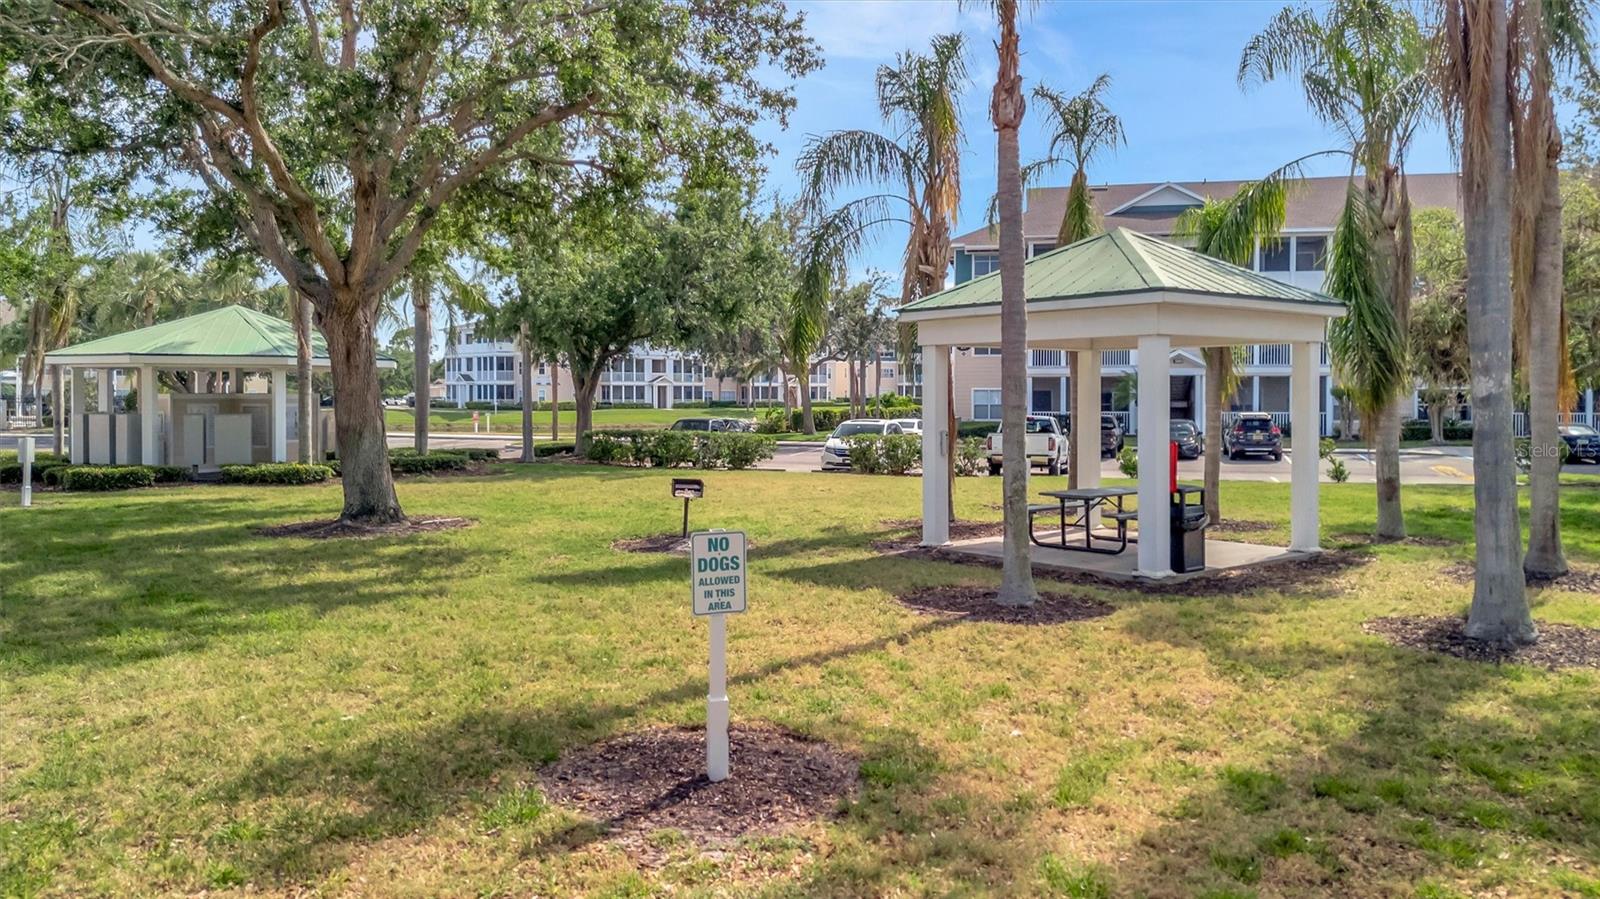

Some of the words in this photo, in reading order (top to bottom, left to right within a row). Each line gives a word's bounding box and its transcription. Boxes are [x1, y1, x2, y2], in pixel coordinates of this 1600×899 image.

[708, 537, 730, 552] NO
[697, 556, 740, 573] DOGS
[698, 575, 740, 587] ALLOWED
[704, 590, 713, 599] IN
[715, 588, 735, 598] THIS
[708, 601, 732, 611] AREA
